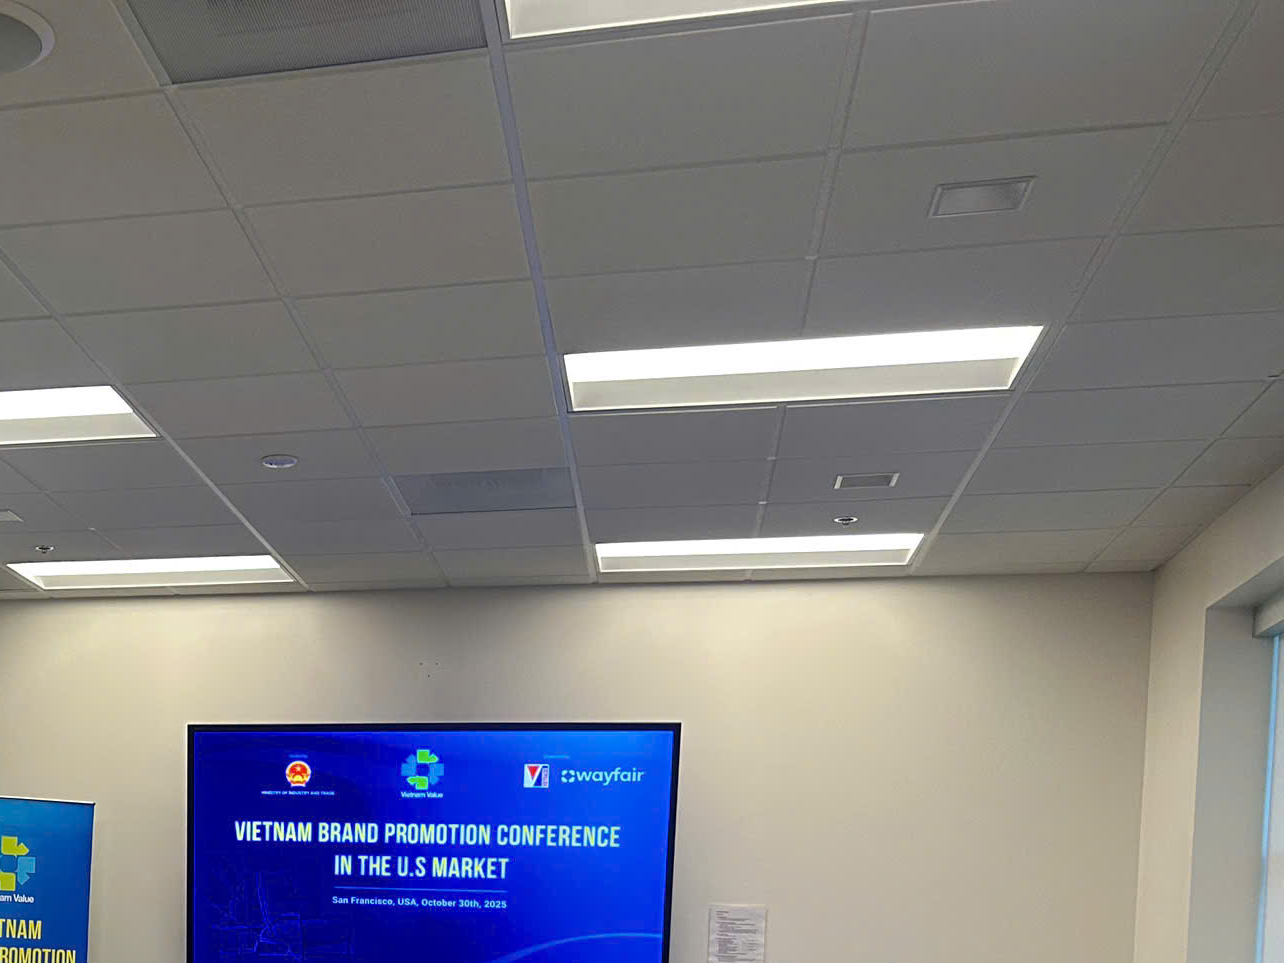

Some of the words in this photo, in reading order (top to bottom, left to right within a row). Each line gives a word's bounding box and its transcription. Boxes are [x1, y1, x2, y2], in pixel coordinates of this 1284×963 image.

[575, 767, 644, 786] wayfair
[235, 821, 312, 842] VIETNAM
[318, 822, 379, 843] BRAND
[385, 823, 491, 845] PROMOTION
[497, 825, 621, 848] CONFERENCE
[334, 855, 352, 876] IN
[358, 855, 391, 877] THE
[397, 856, 426, 877] U.S
[432, 857, 509, 879] MARKET
[13, 893, 34, 903] Value
[332, 896, 348, 904] San
[351, 897, 396, 907] Francisco,
[397, 898, 419, 907] USA,
[421, 899, 457, 907] October
[459, 900, 481, 909] 30th,
[484, 900, 507, 908] 2025
